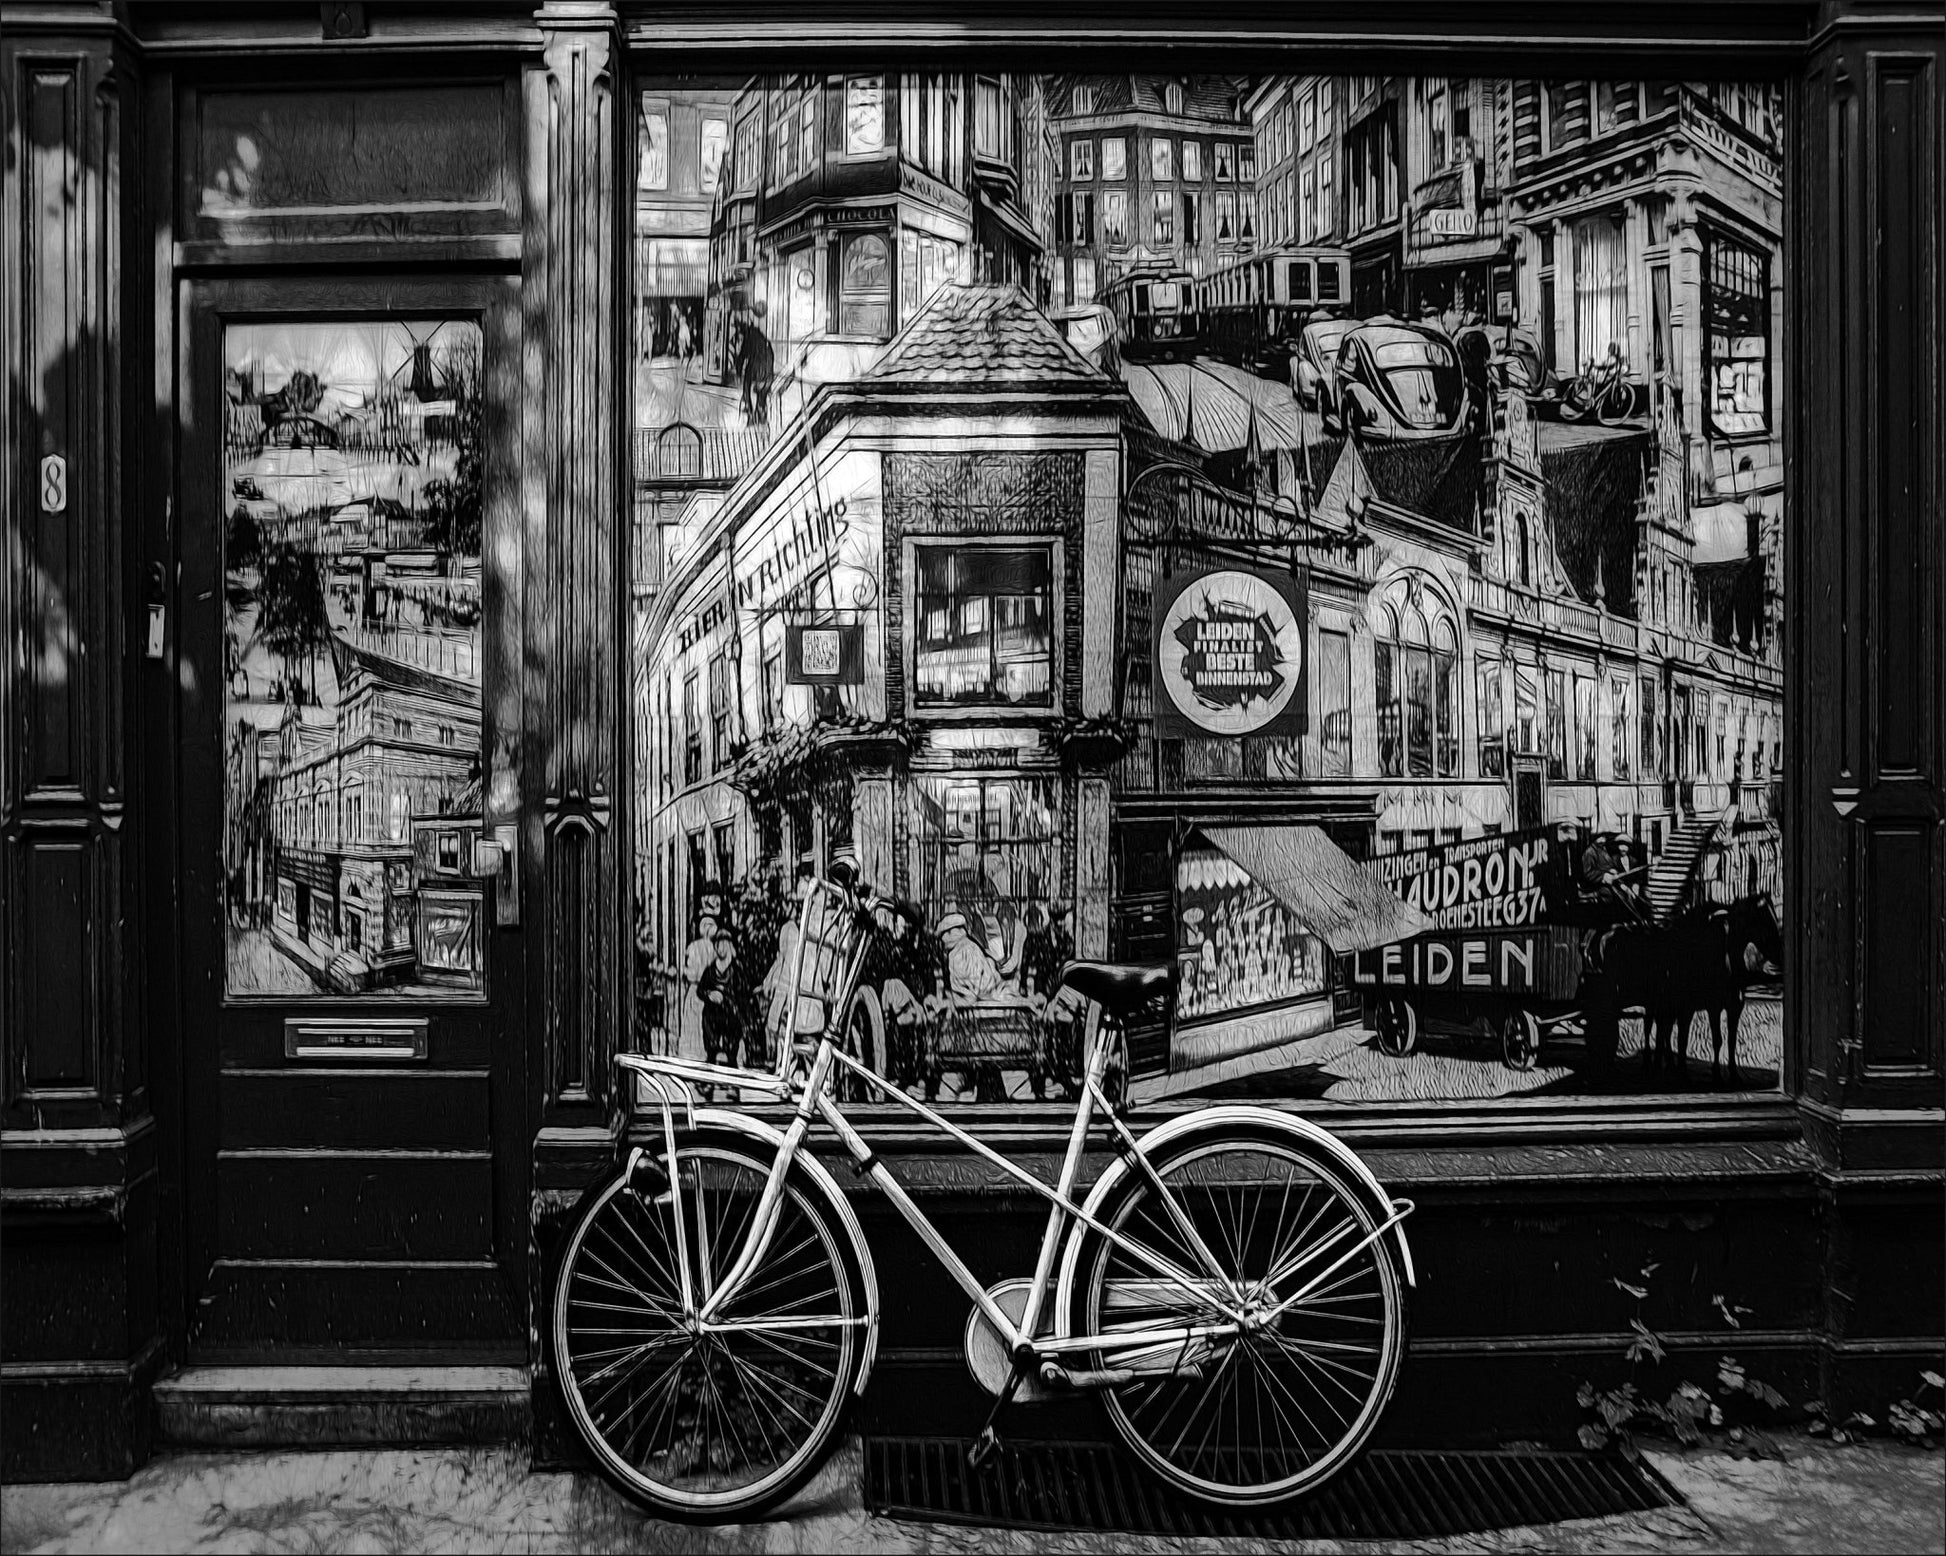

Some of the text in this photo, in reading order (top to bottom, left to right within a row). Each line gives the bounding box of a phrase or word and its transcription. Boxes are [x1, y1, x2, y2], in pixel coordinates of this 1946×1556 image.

[45, 461, 62, 510] 8
[1196, 622, 1255, 641] LEIDEN
[1193, 640, 1264, 654] FINALIST
[1205, 653, 1255, 671] BESTE
[1195, 671, 1273, 686] BINNENSTAD
[1444, 838, 1505, 865] TRANSPORTEN
[1354, 938, 1534, 987] LEIDEN
